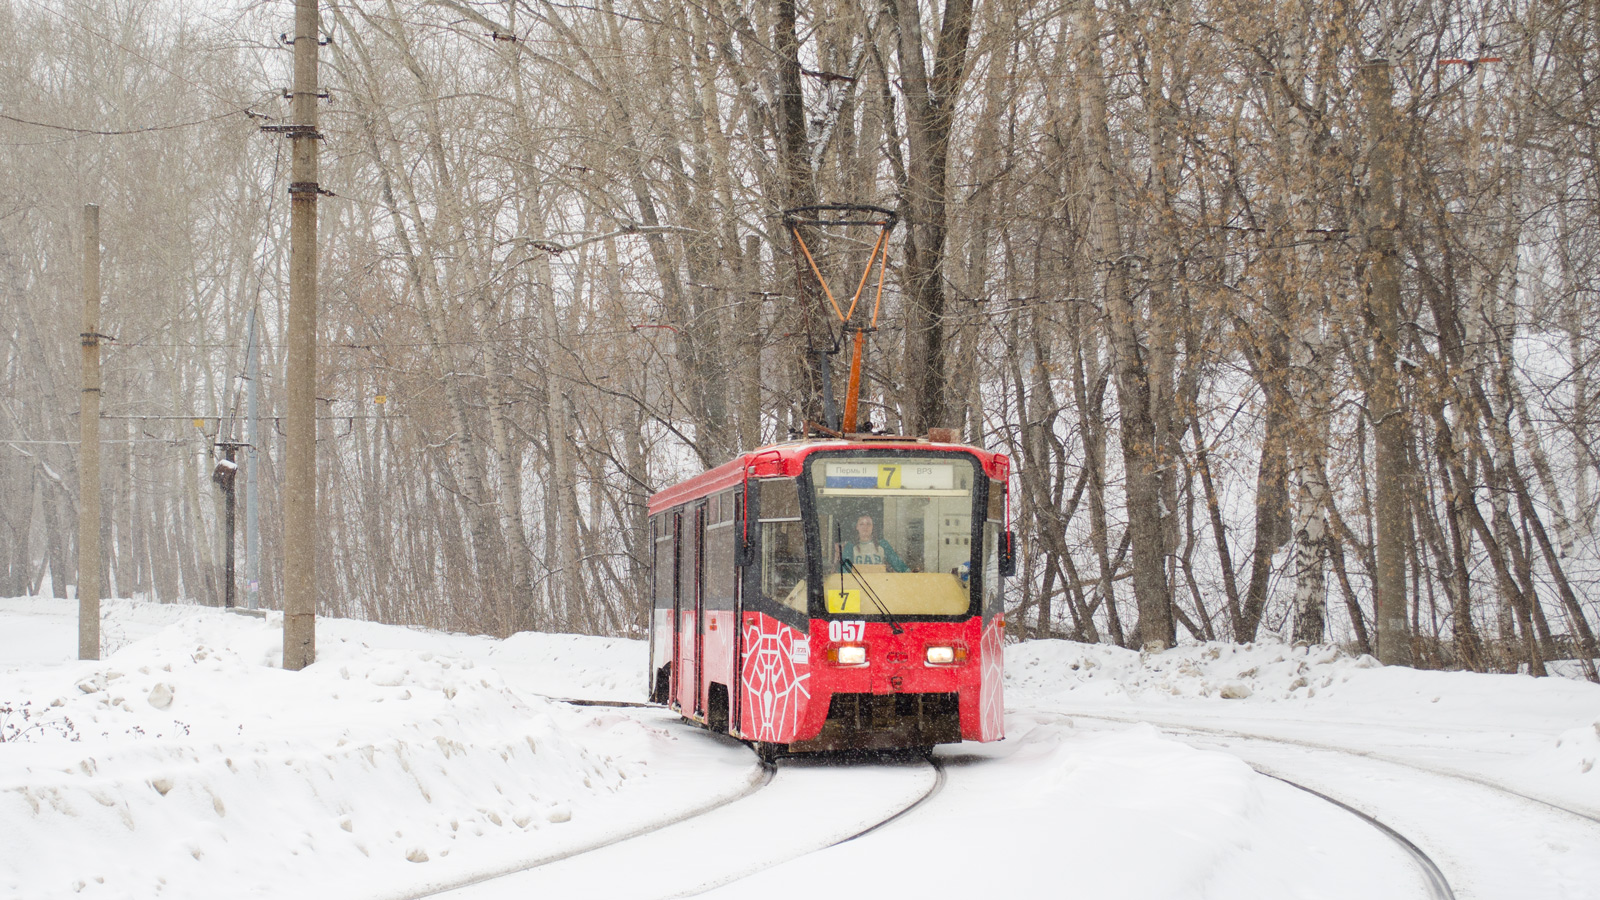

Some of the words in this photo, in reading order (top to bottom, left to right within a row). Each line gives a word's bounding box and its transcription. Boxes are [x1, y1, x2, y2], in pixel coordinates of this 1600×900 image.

[836, 466, 860, 475] Пермь
[883, 467, 896, 487] 7
[839, 592, 850, 610] 7
[829, 620, 865, 642] 057
